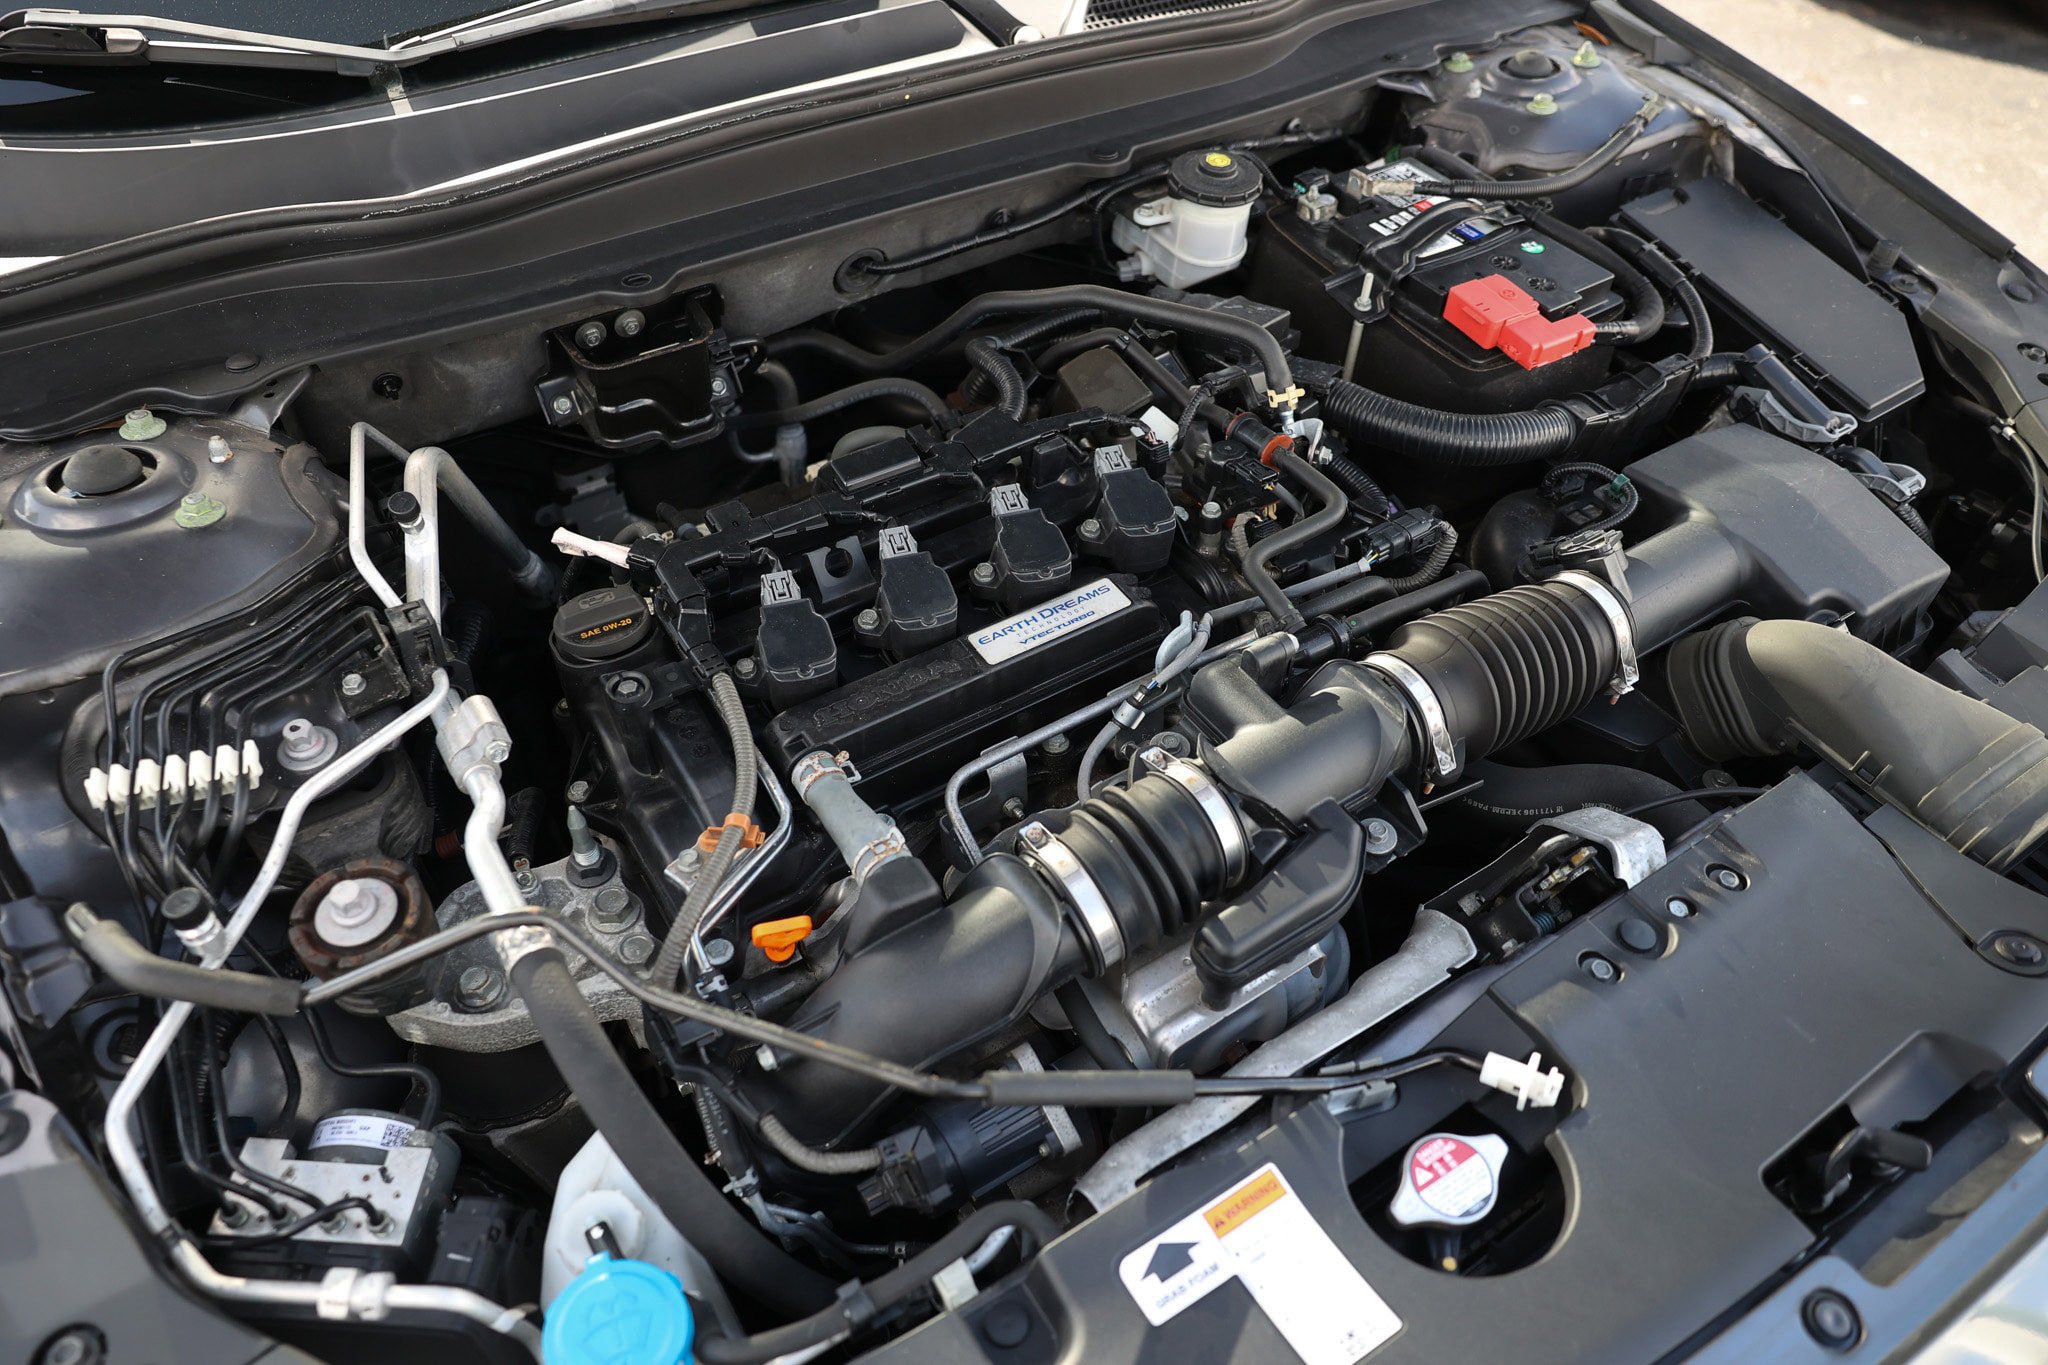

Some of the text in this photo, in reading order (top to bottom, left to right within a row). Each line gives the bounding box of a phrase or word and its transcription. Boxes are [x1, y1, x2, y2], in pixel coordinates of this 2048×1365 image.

[580, 618, 632, 639] SAE 0W-20
[978, 585, 1111, 645] EARTH DREAMS
[1016, 606, 1085, 638] TECHNOLOGY
[1225, 1181, 1278, 1219] WARNING
